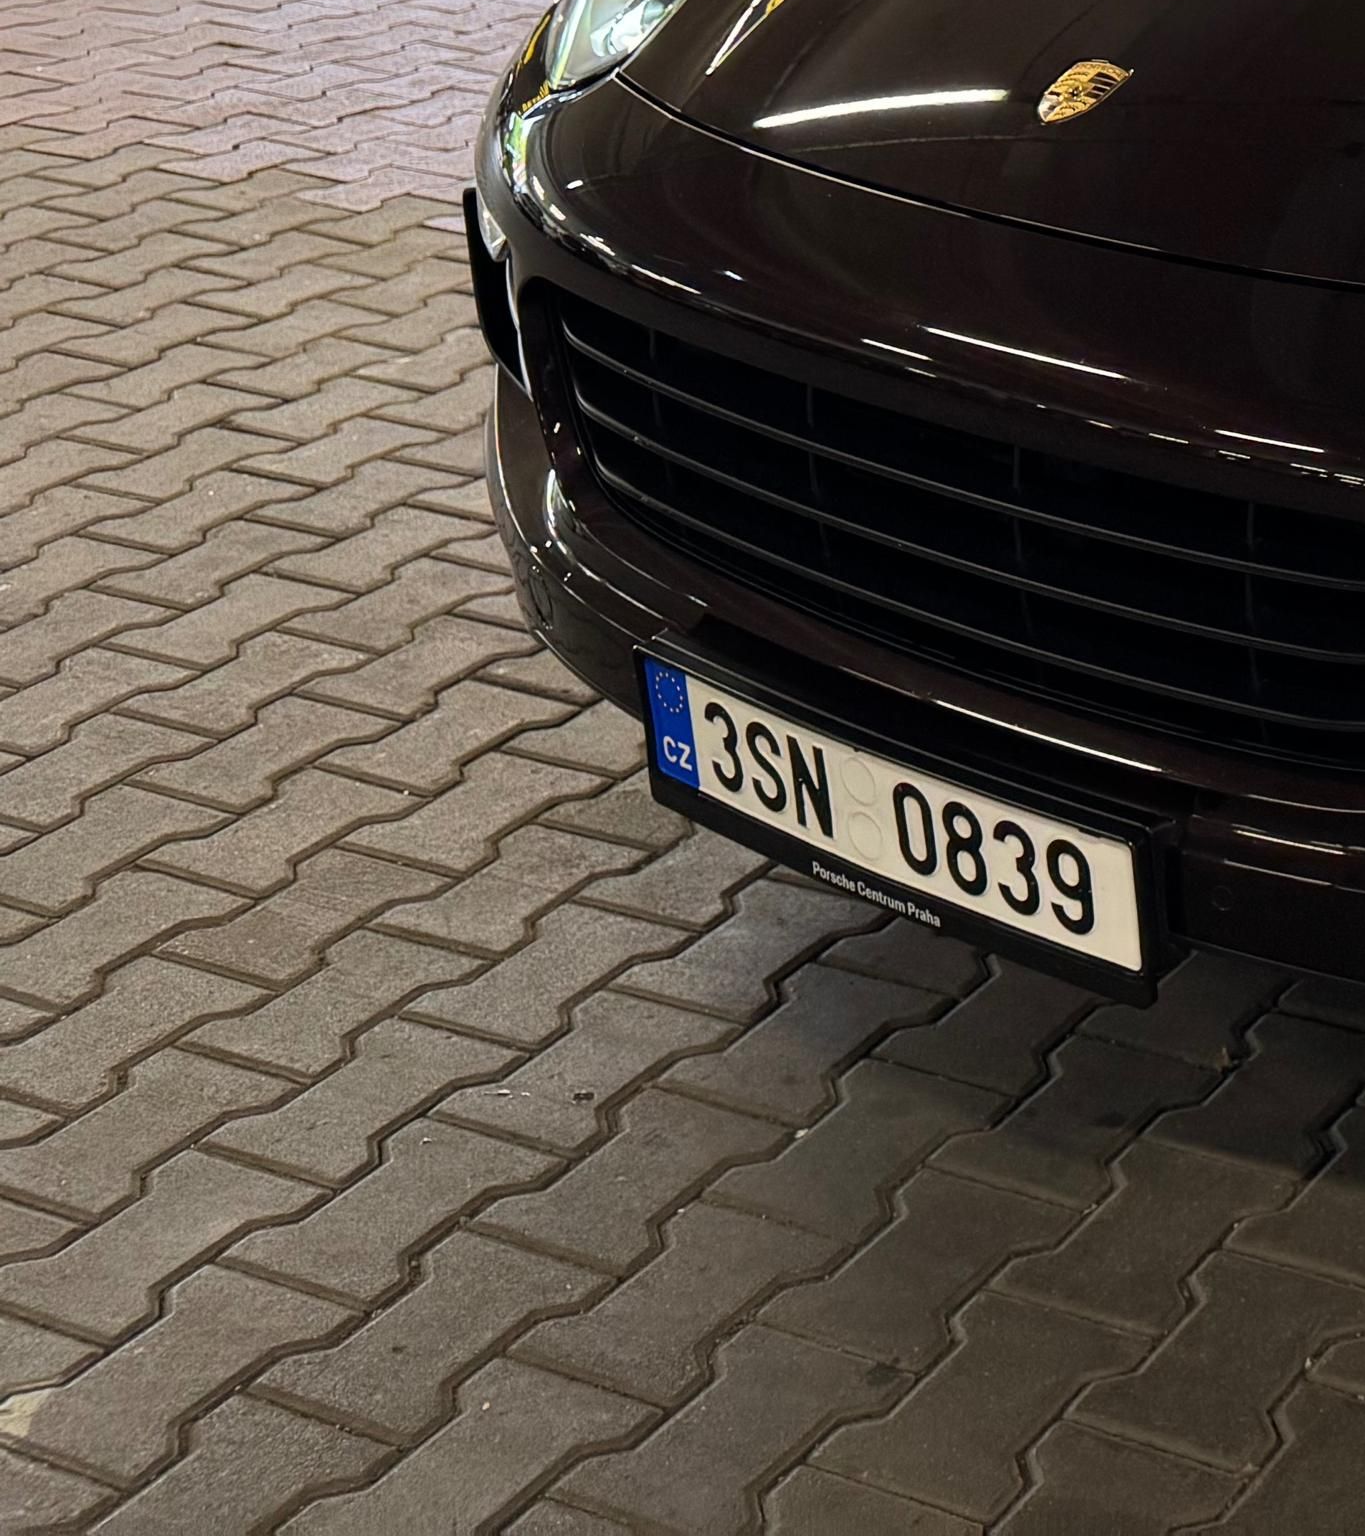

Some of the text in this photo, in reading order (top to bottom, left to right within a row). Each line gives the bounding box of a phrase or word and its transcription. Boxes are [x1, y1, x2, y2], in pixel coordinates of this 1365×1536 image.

[662, 735, 693, 771] CZ
[704, 701, 1096, 935] 3SN 0839
[812, 860, 941, 928] Porsche Centrum Praha
